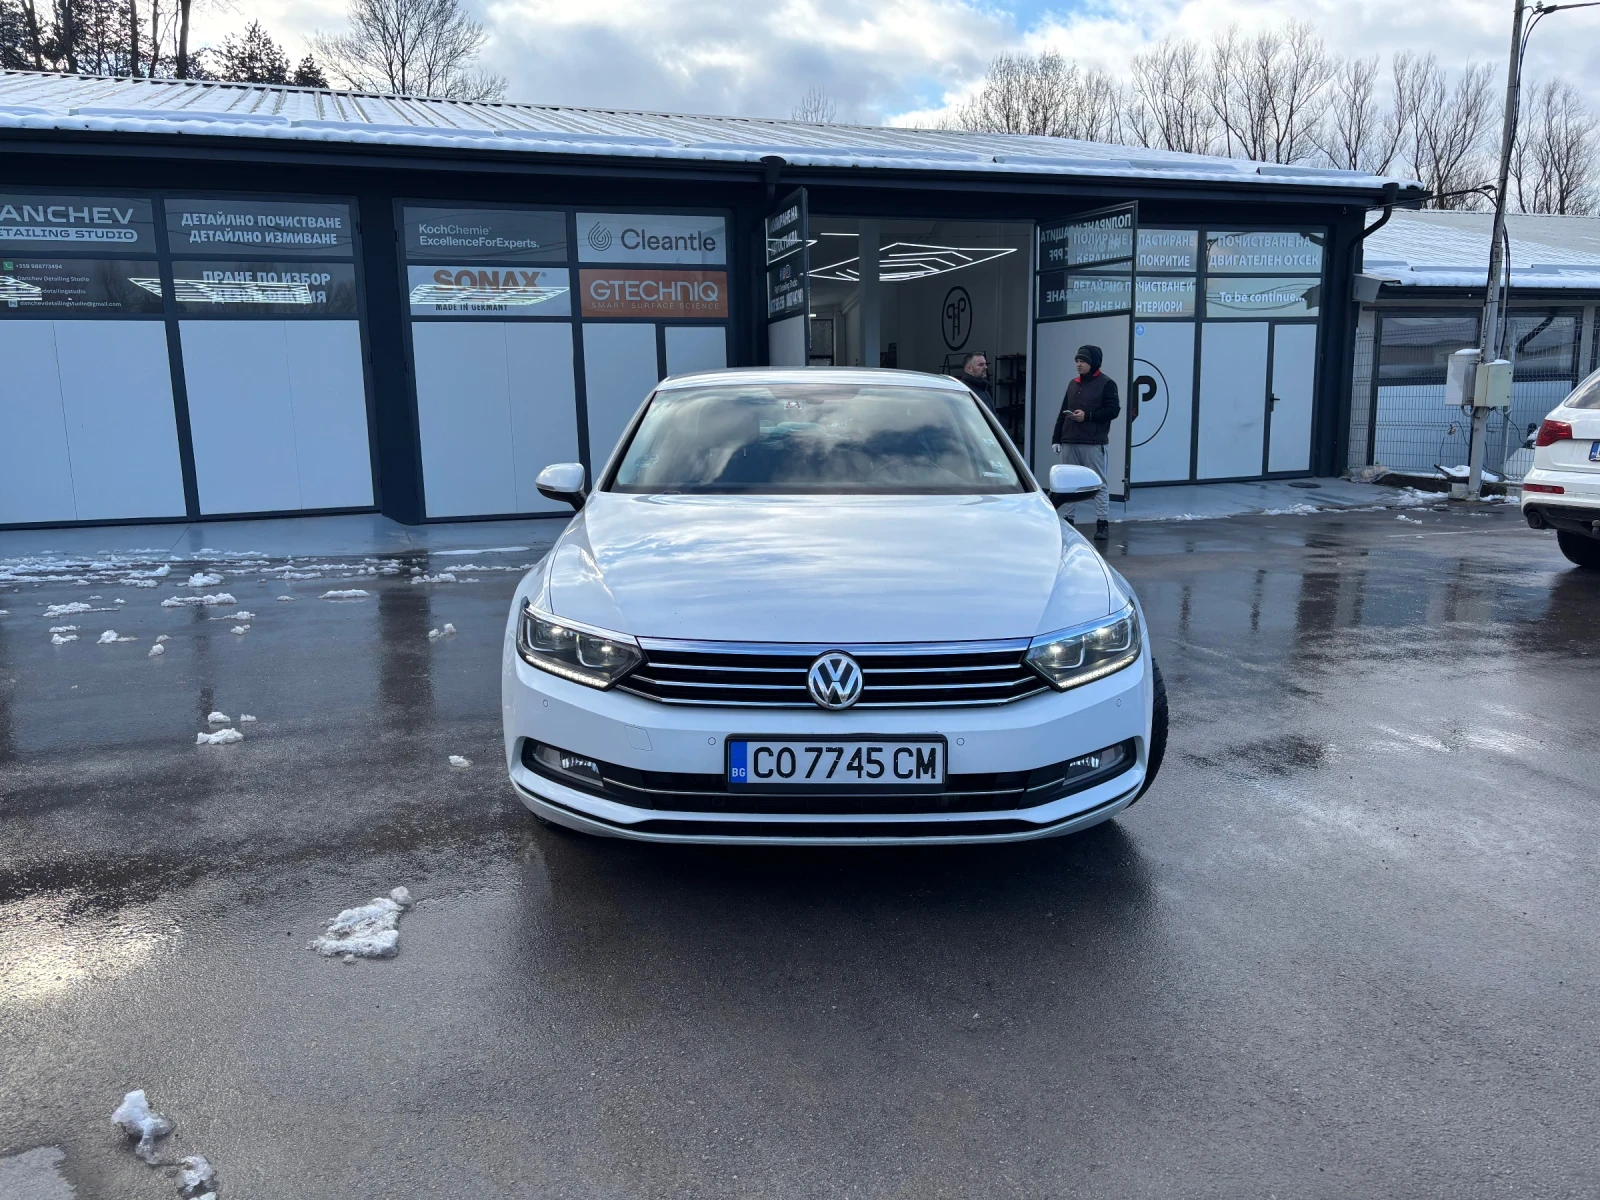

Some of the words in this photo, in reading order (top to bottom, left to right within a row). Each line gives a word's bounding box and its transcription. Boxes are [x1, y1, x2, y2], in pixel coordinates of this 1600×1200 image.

[181, 211, 254, 226] ДЕТАЙЛНО
[258, 215, 341, 229] ПОЧИСТВАНЕ
[75, 230, 134, 240] STUDIO
[189, 228, 261, 243] ДЕТАЙЛНО
[265, 232, 337, 245] ИЗМИВАНЕ
[620, 228, 717, 252] Cleantle
[1138, 234, 1195, 247] ПАСТИРАНЕ
[1217, 235, 1294, 248] ПОЧИСТВАНЕ
[1295, 236, 1311, 248] НА
[419, 236, 540, 249] ExcellenceForExperts.
[1139, 254, 1190, 267] ПОКРИТИЕ
[1208, 254, 1282, 268] ДВИГАТЕЛЕН
[1283, 254, 1319, 266] ОТСЕК
[281, 272, 331, 286] ИЗБОР
[1219, 291, 1232, 303] To
[1234, 291, 1248, 303] be
[1249, 291, 1305, 303] continue...
[435, 303, 457, 311] MADE
[460, 303, 469, 311] IN
[631, 302, 675, 310] SURFACE
[1081, 300, 1114, 313] ПРАНЕ
[731, 767, 746, 778] BG
